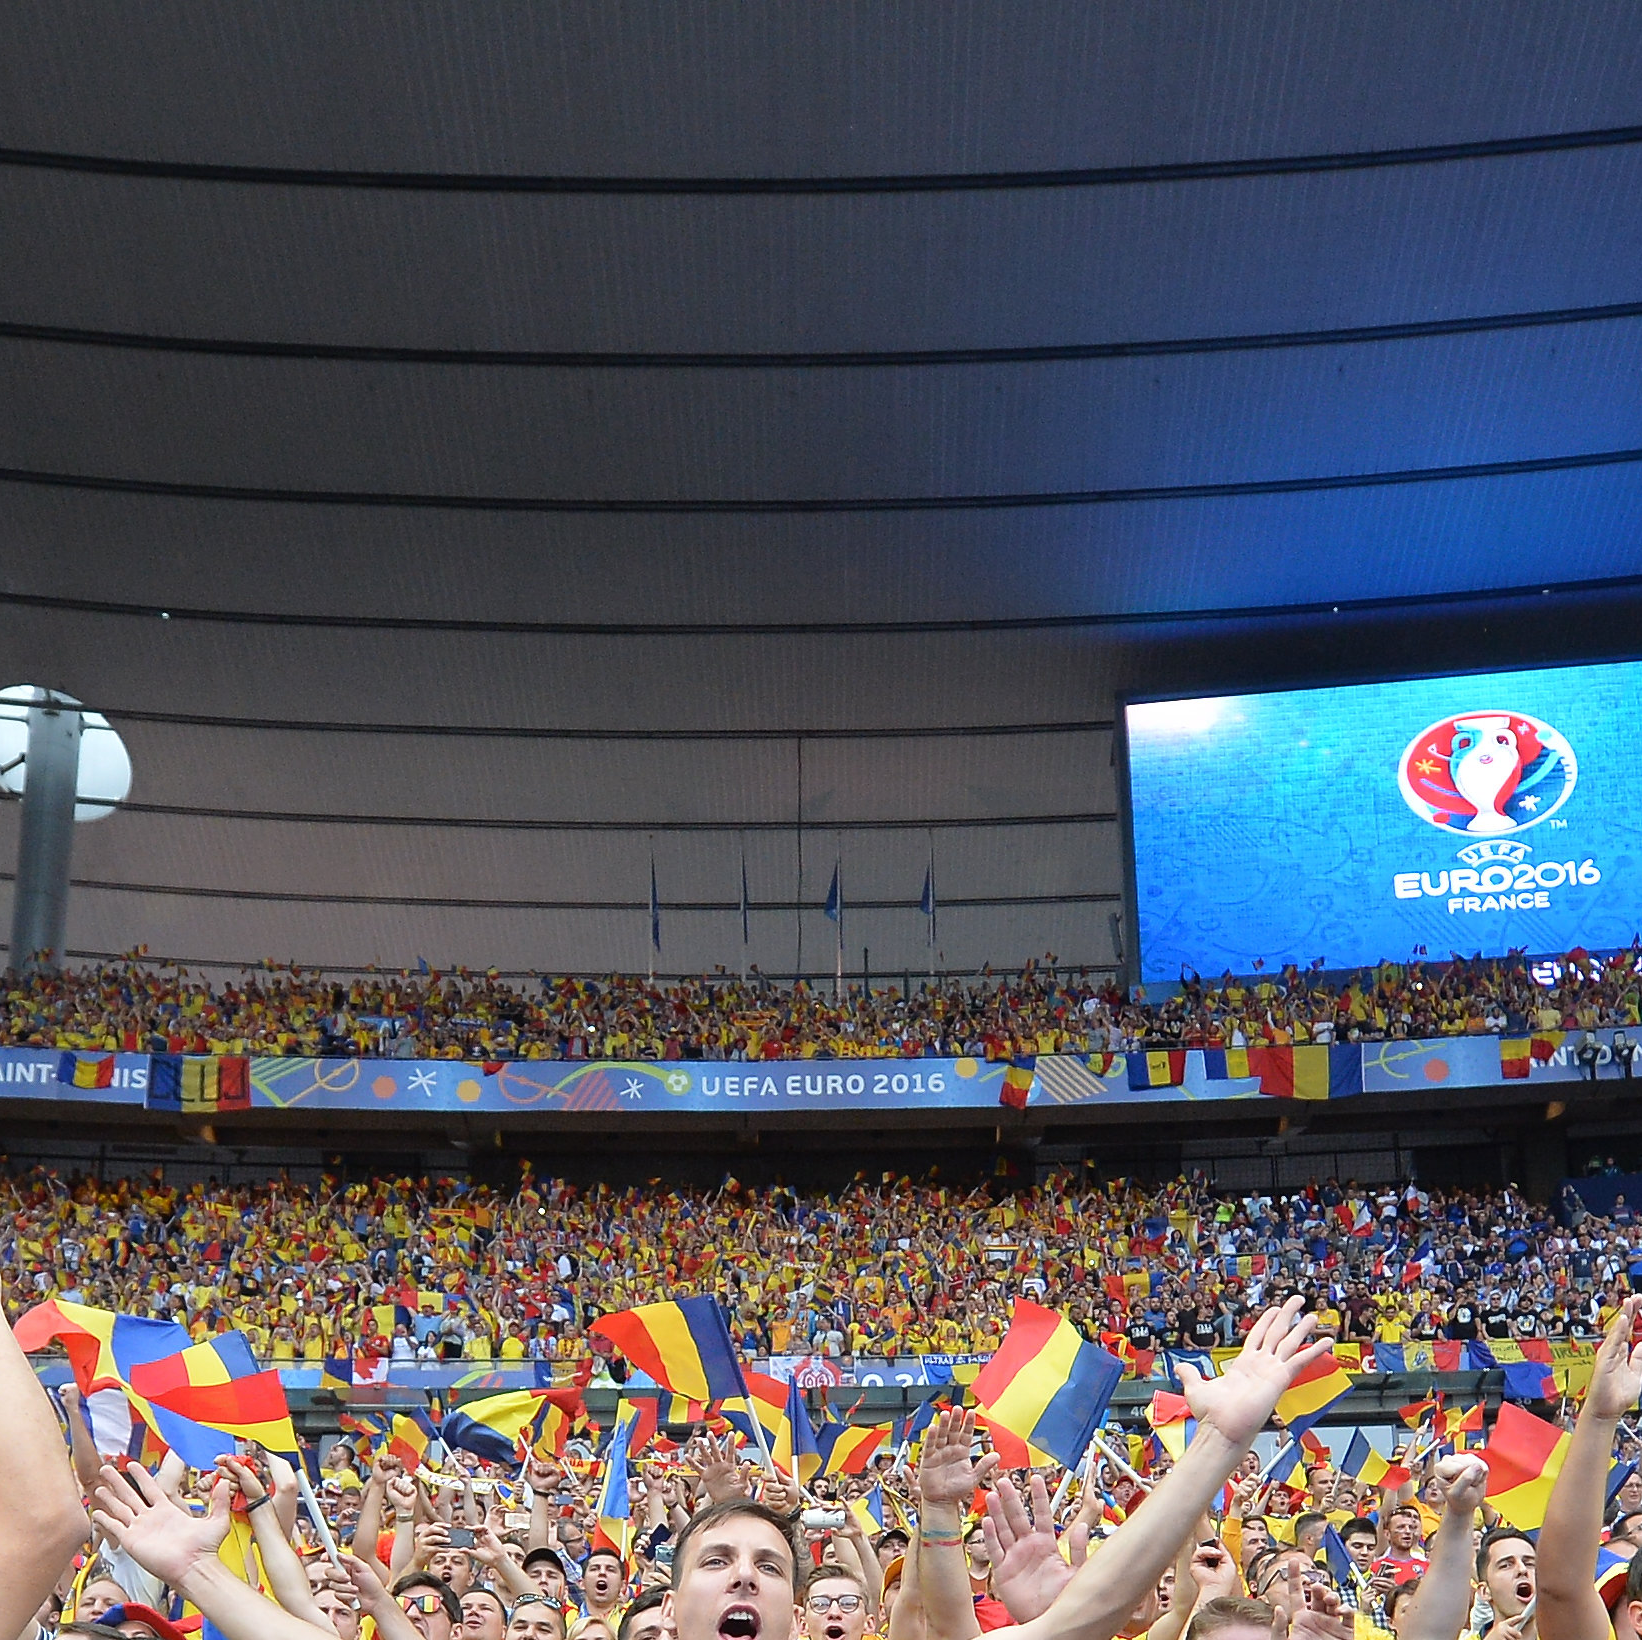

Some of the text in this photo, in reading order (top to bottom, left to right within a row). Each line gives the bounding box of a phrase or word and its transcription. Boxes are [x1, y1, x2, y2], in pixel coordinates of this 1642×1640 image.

[1461, 843, 1526, 863] UEFA
[1448, 891, 1551, 914] FRANCE
[701, 1072, 946, 1097] UEFA EURO 2016
